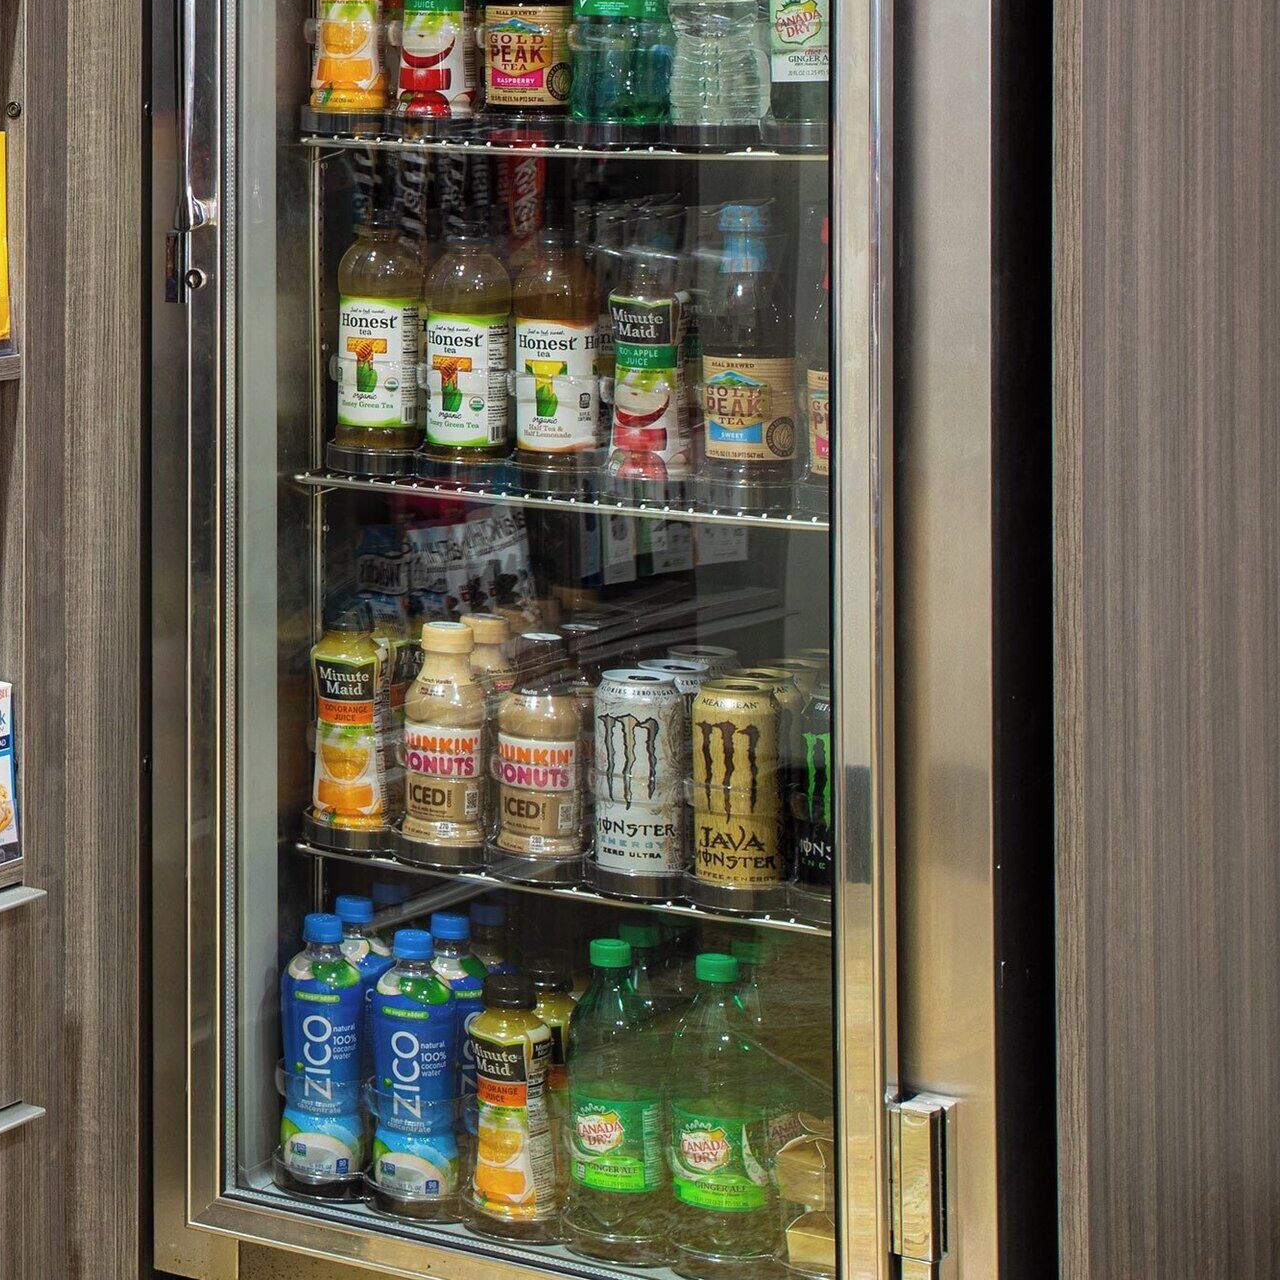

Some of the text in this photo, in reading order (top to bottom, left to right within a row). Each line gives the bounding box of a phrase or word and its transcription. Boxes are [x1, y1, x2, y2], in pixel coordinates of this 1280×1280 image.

[489, 34, 545, 46] GOLD
[490, 45, 544, 64] PEAK
[502, 63, 528, 72] TEA
[497, 77, 536, 87] RASPBERRY
[612, 311, 663, 326] Minute
[619, 325, 659, 339] Maid
[318, 667, 370, 684] Minute
[326, 681, 364, 697] Maid
[700, 826, 764, 849] JAVA
[603, 848, 661, 859] ZERO ULTRA
[589, 1135, 612, 1147] DRY
